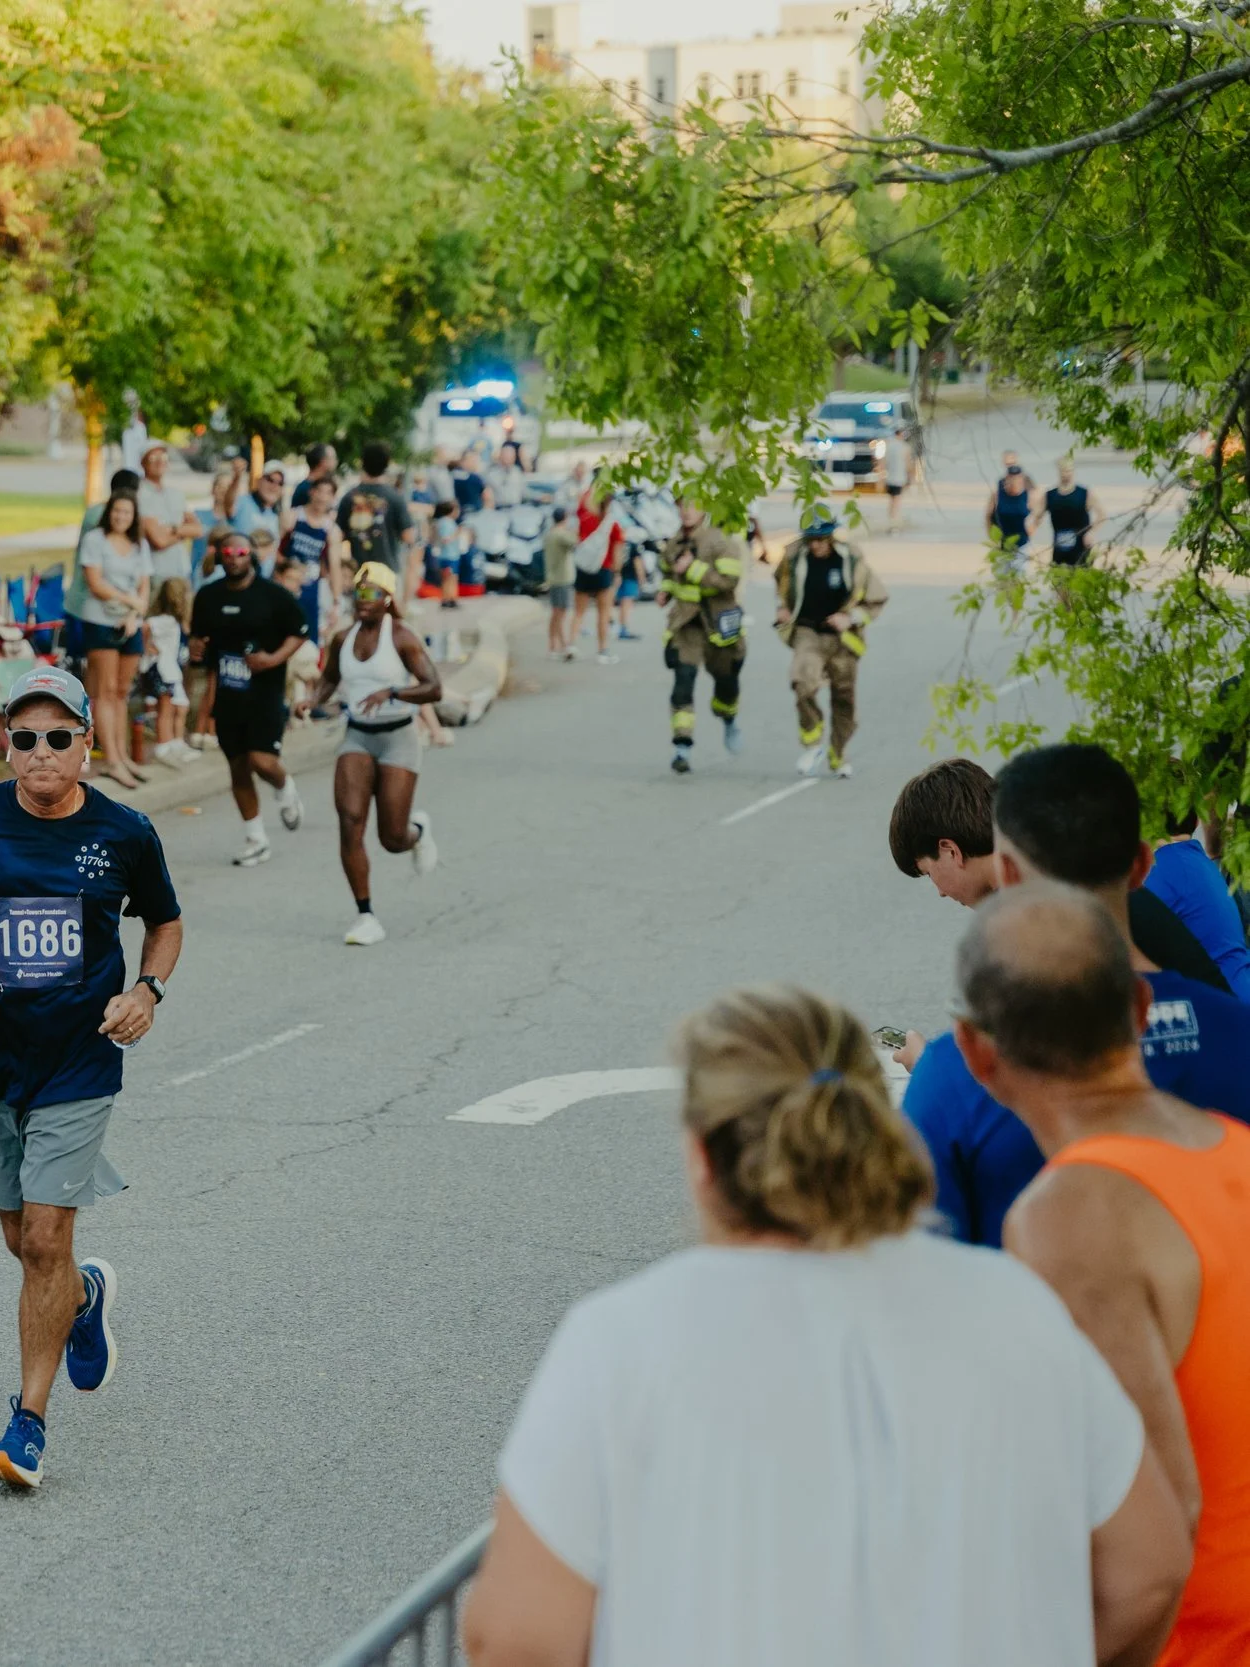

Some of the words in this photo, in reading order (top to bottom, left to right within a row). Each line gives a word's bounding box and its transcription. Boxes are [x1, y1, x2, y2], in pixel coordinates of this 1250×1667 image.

[81, 855, 104, 867] 1776
[41, 908, 67, 916] Foundation
[22, 971, 47, 979] Lexington
